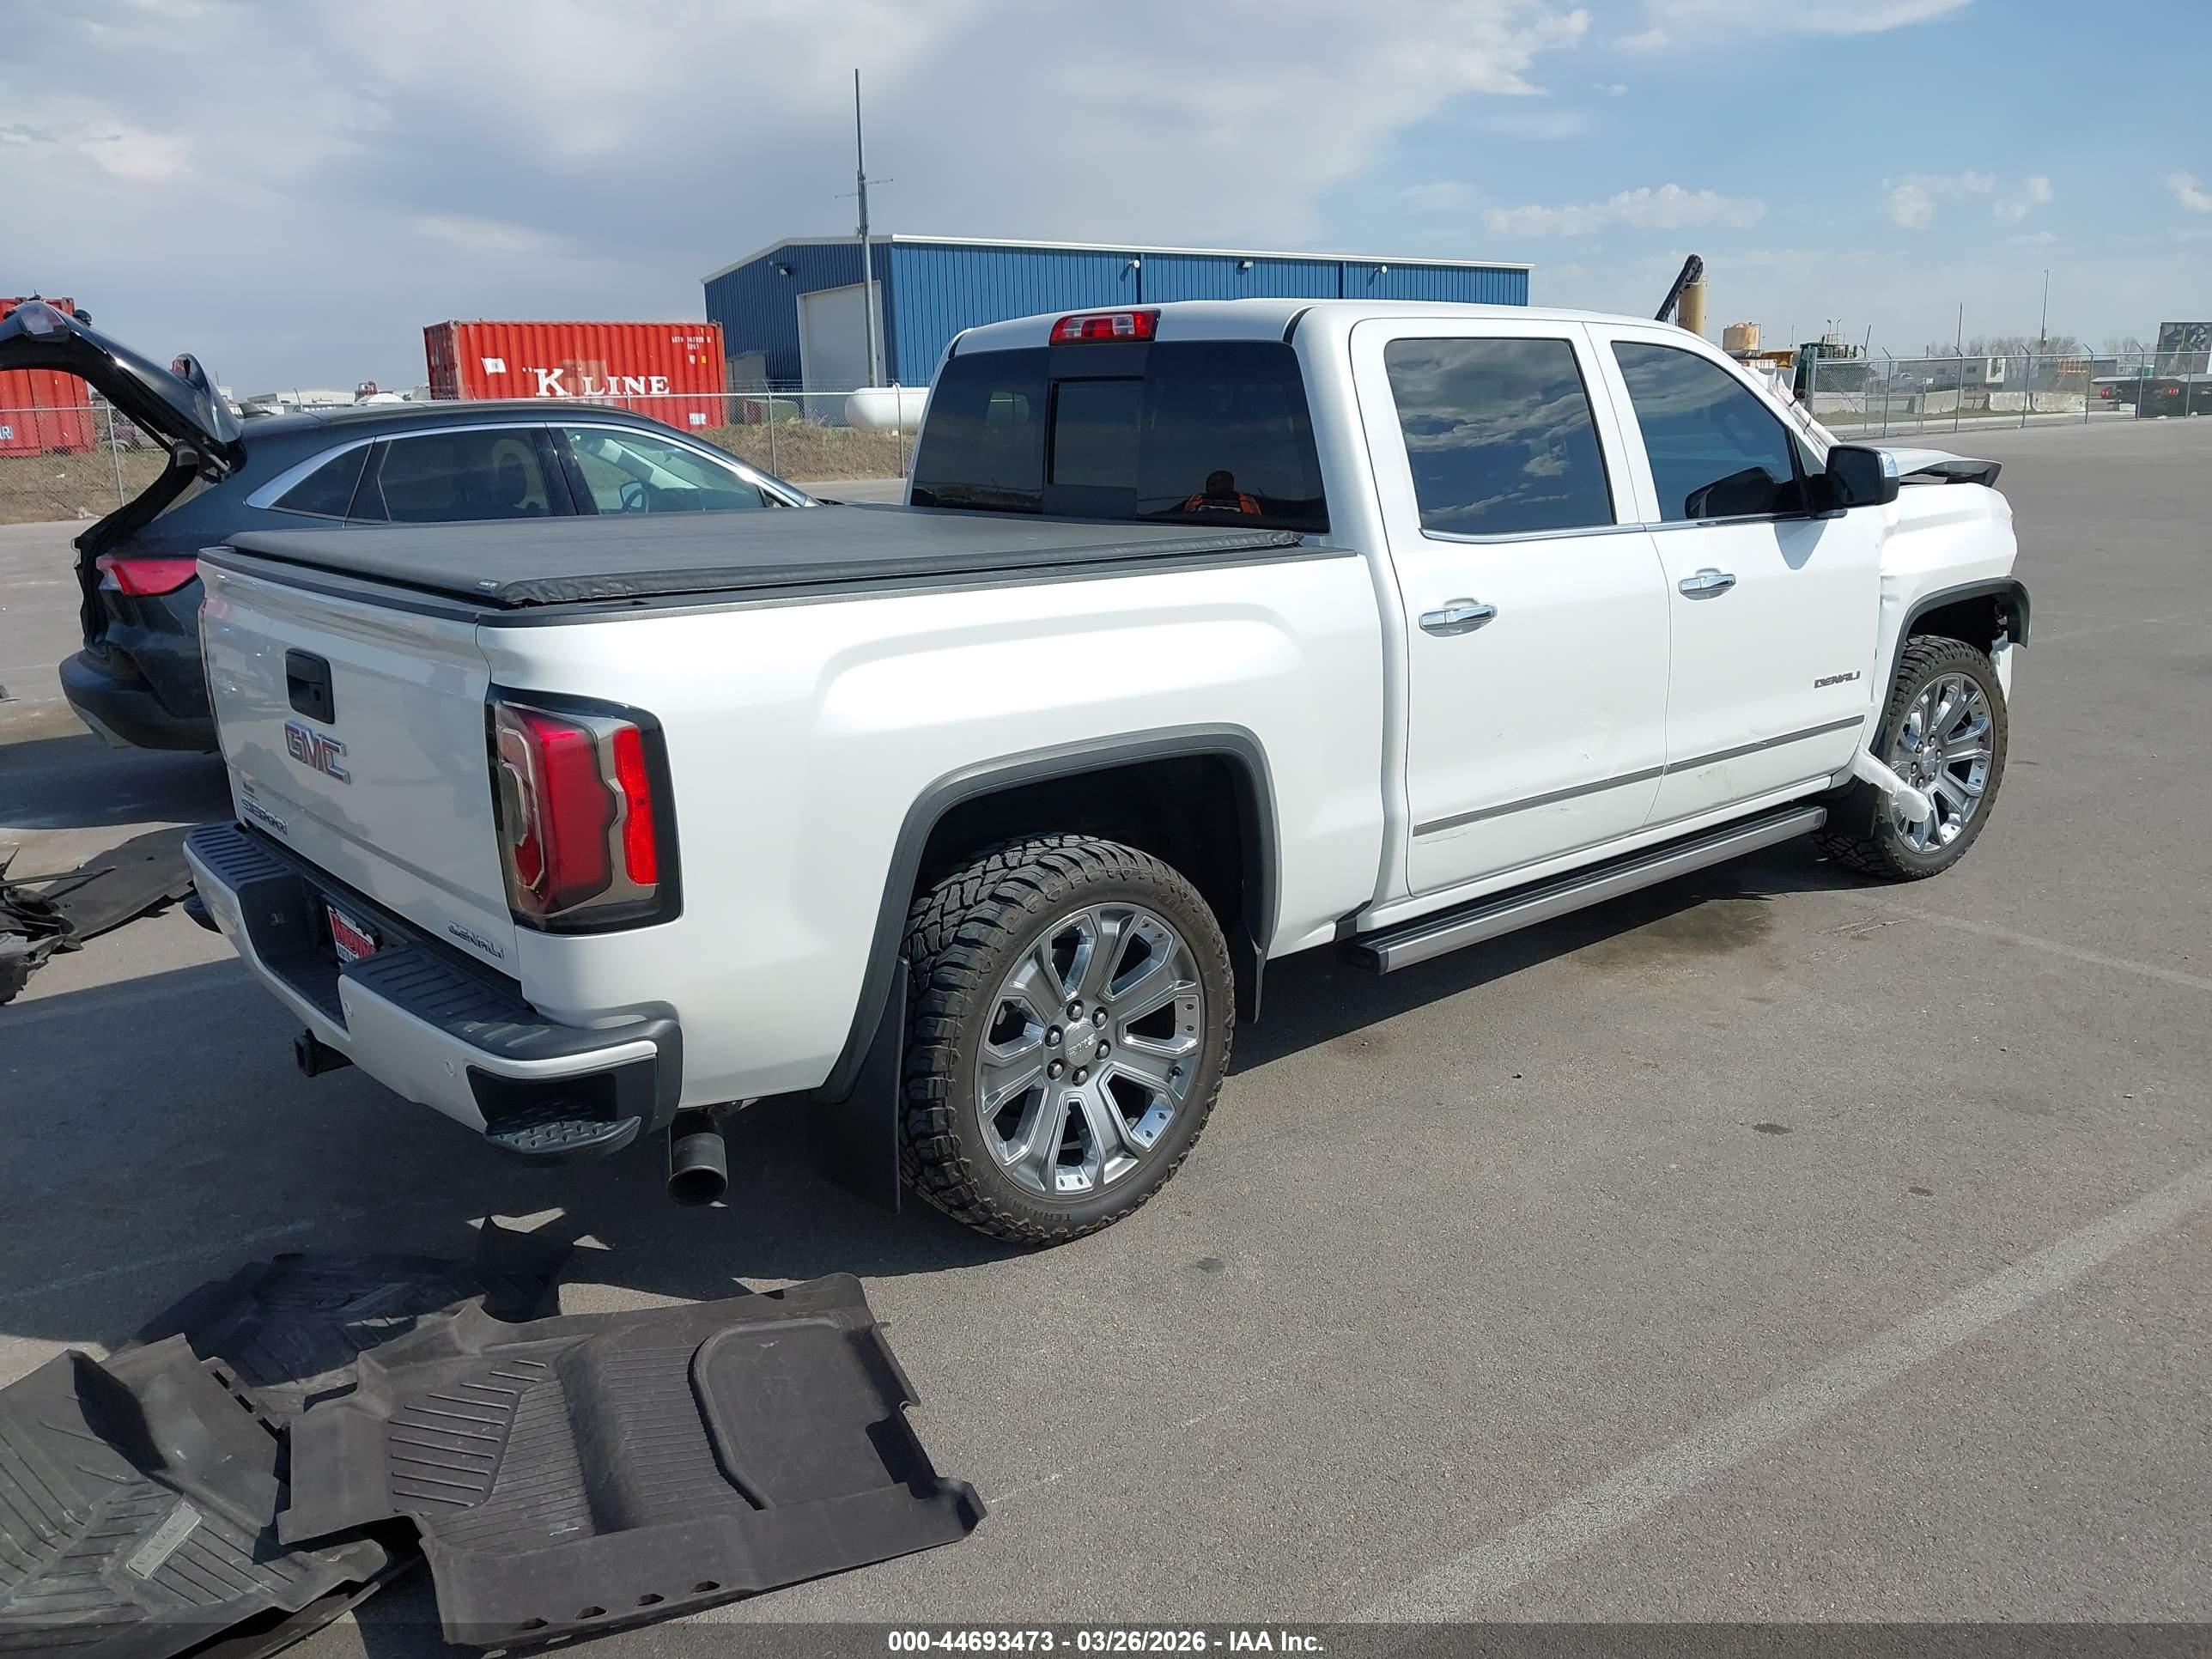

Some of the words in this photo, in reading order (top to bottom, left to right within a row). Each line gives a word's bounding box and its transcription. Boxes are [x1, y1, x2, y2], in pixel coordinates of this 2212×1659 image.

[582, 375, 670, 396] LINE
[1814, 671, 1861, 689] DENALI
[285, 720, 351, 785] GMC
[241, 797, 288, 836] SIERRA
[447, 920, 504, 960] DENALI
